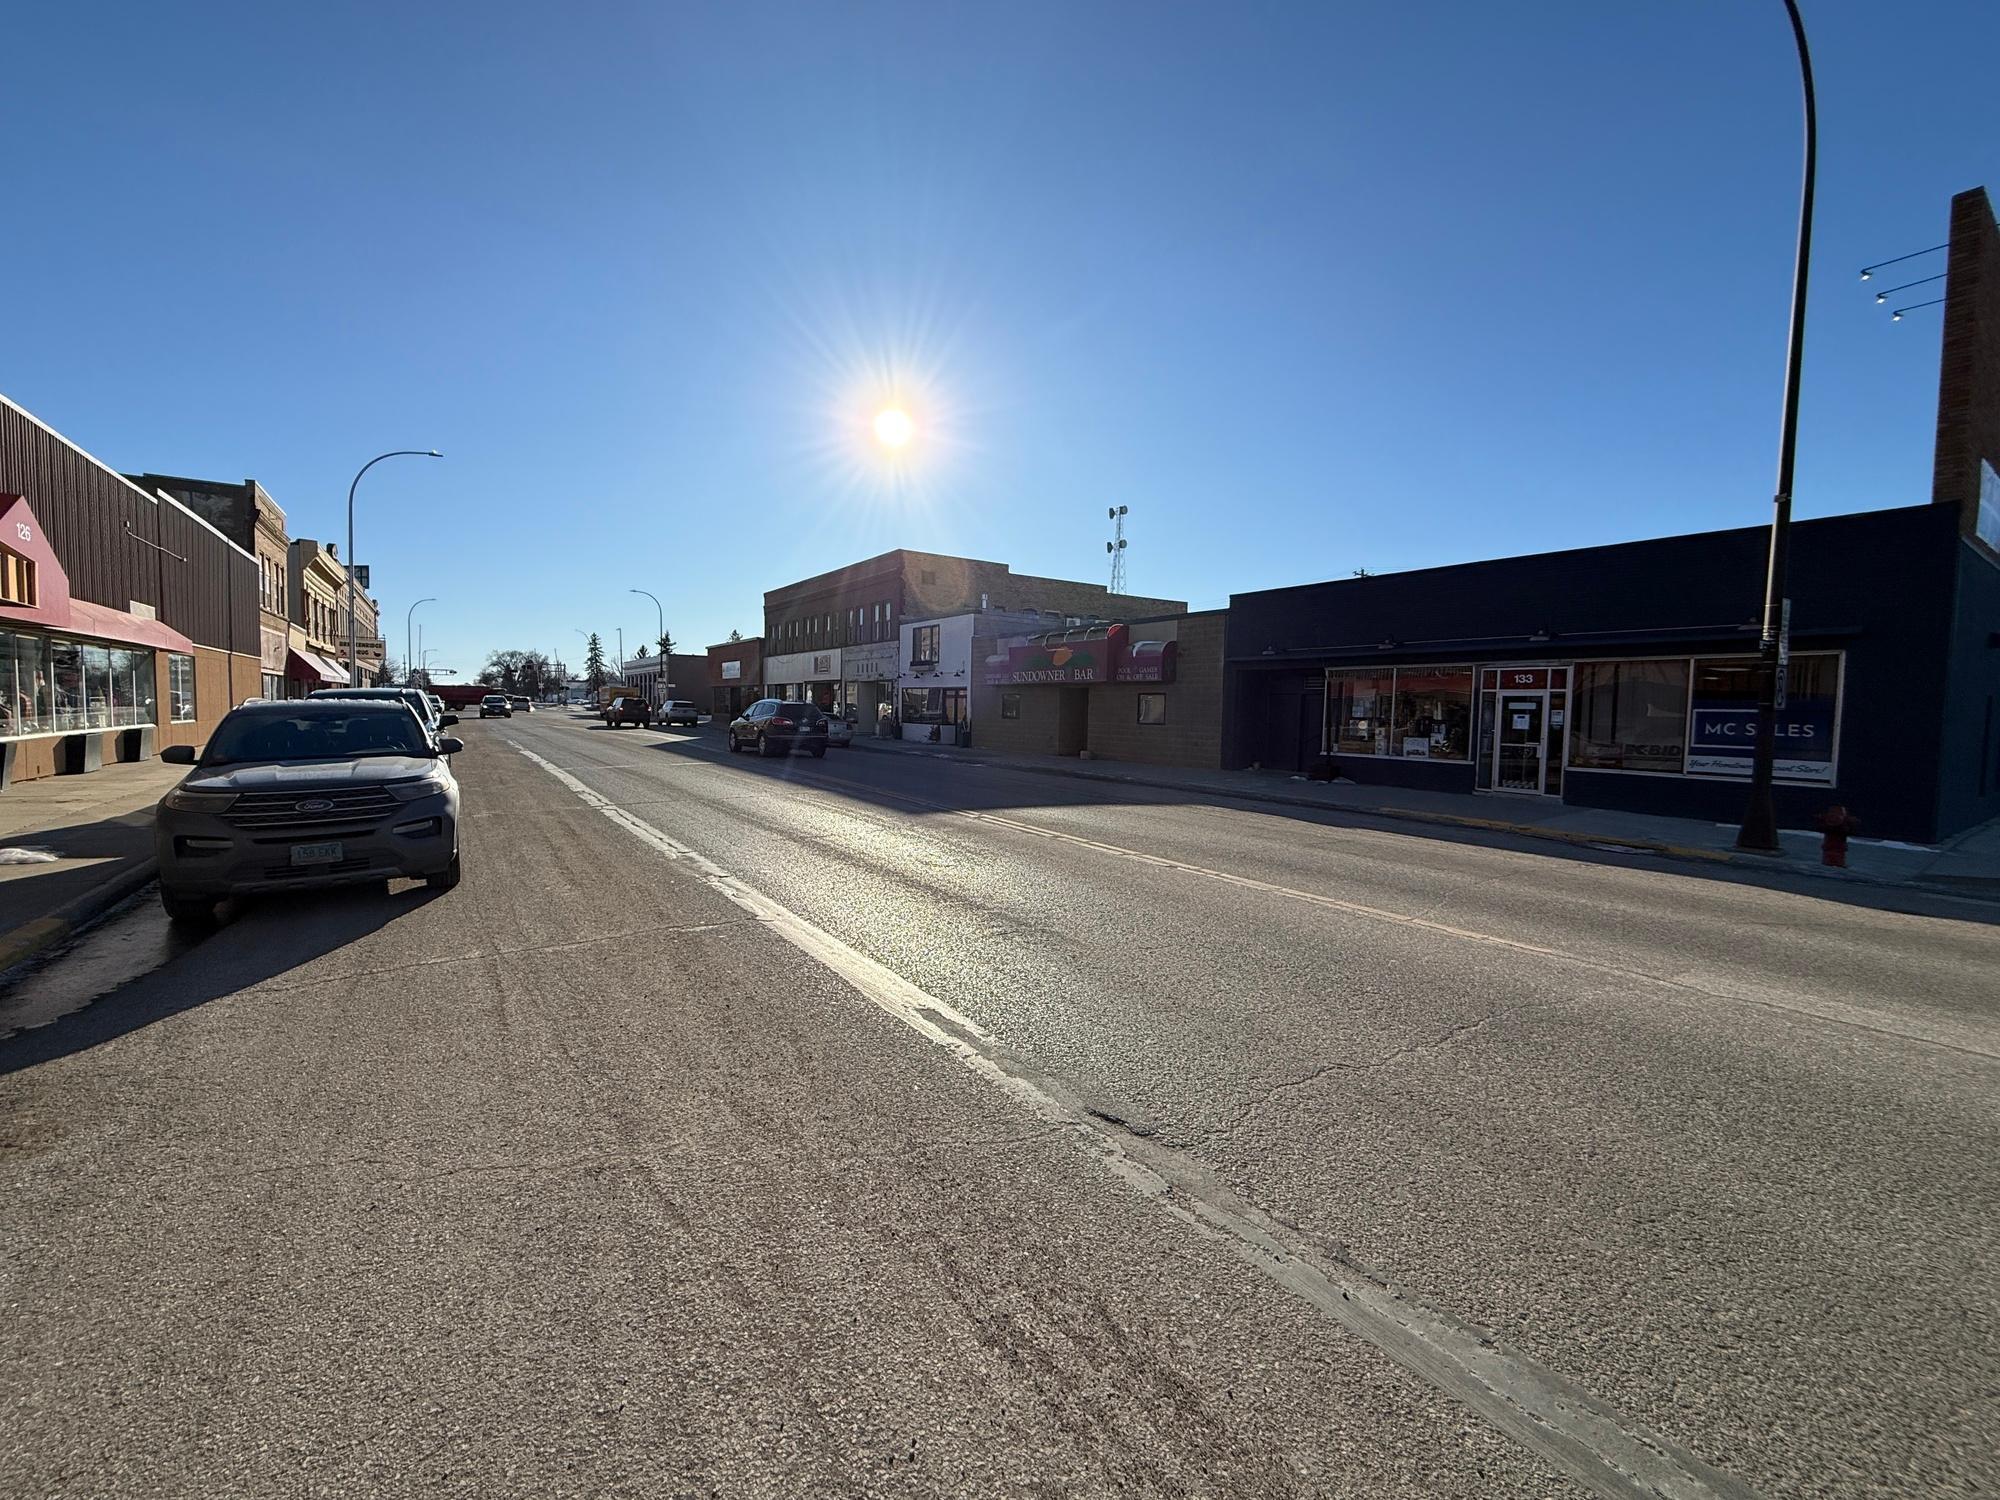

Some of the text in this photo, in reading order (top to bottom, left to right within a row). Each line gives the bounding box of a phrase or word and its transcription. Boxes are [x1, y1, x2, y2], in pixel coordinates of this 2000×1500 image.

[16, 522, 31, 542] 126
[1012, 668, 1094, 682] SUNDOWNER BAR
[1514, 674, 1533, 684] 133
[1705, 722, 1814, 737] MC SLES
[303, 800, 325, 810] Ford
